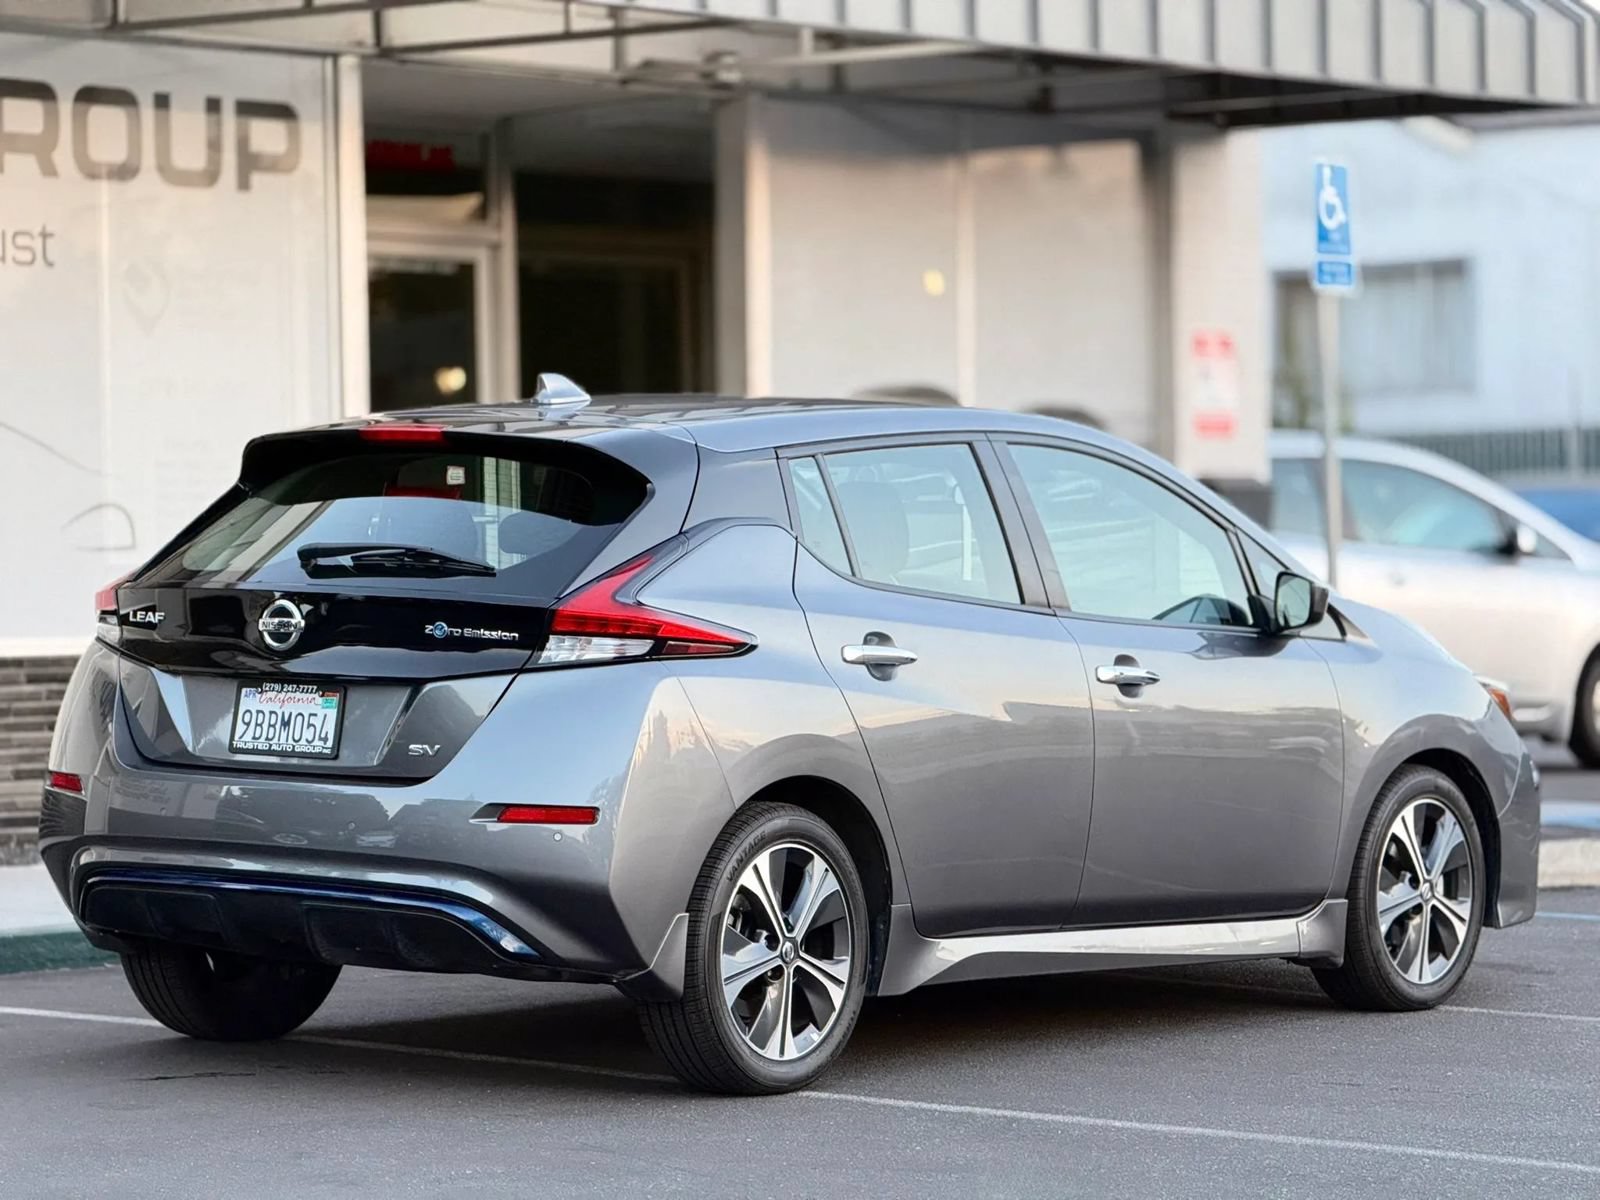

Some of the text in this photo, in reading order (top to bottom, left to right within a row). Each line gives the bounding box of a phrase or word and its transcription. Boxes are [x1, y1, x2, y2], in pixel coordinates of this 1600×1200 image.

[129, 610, 166, 624] LEAF
[261, 620, 298, 630] NISSAN
[463, 627, 520, 641] Emission
[262, 682, 317, 693] (279) 247-7777
[258, 690, 318, 709] California
[238, 709, 329, 746] 9BBM054
[232, 741, 269, 751] TRUSTED
[271, 743, 293, 752] AUTO
[294, 745, 323, 754] GROUP
[407, 743, 441, 756] SV
[726, 830, 768, 882] VANTAGE
